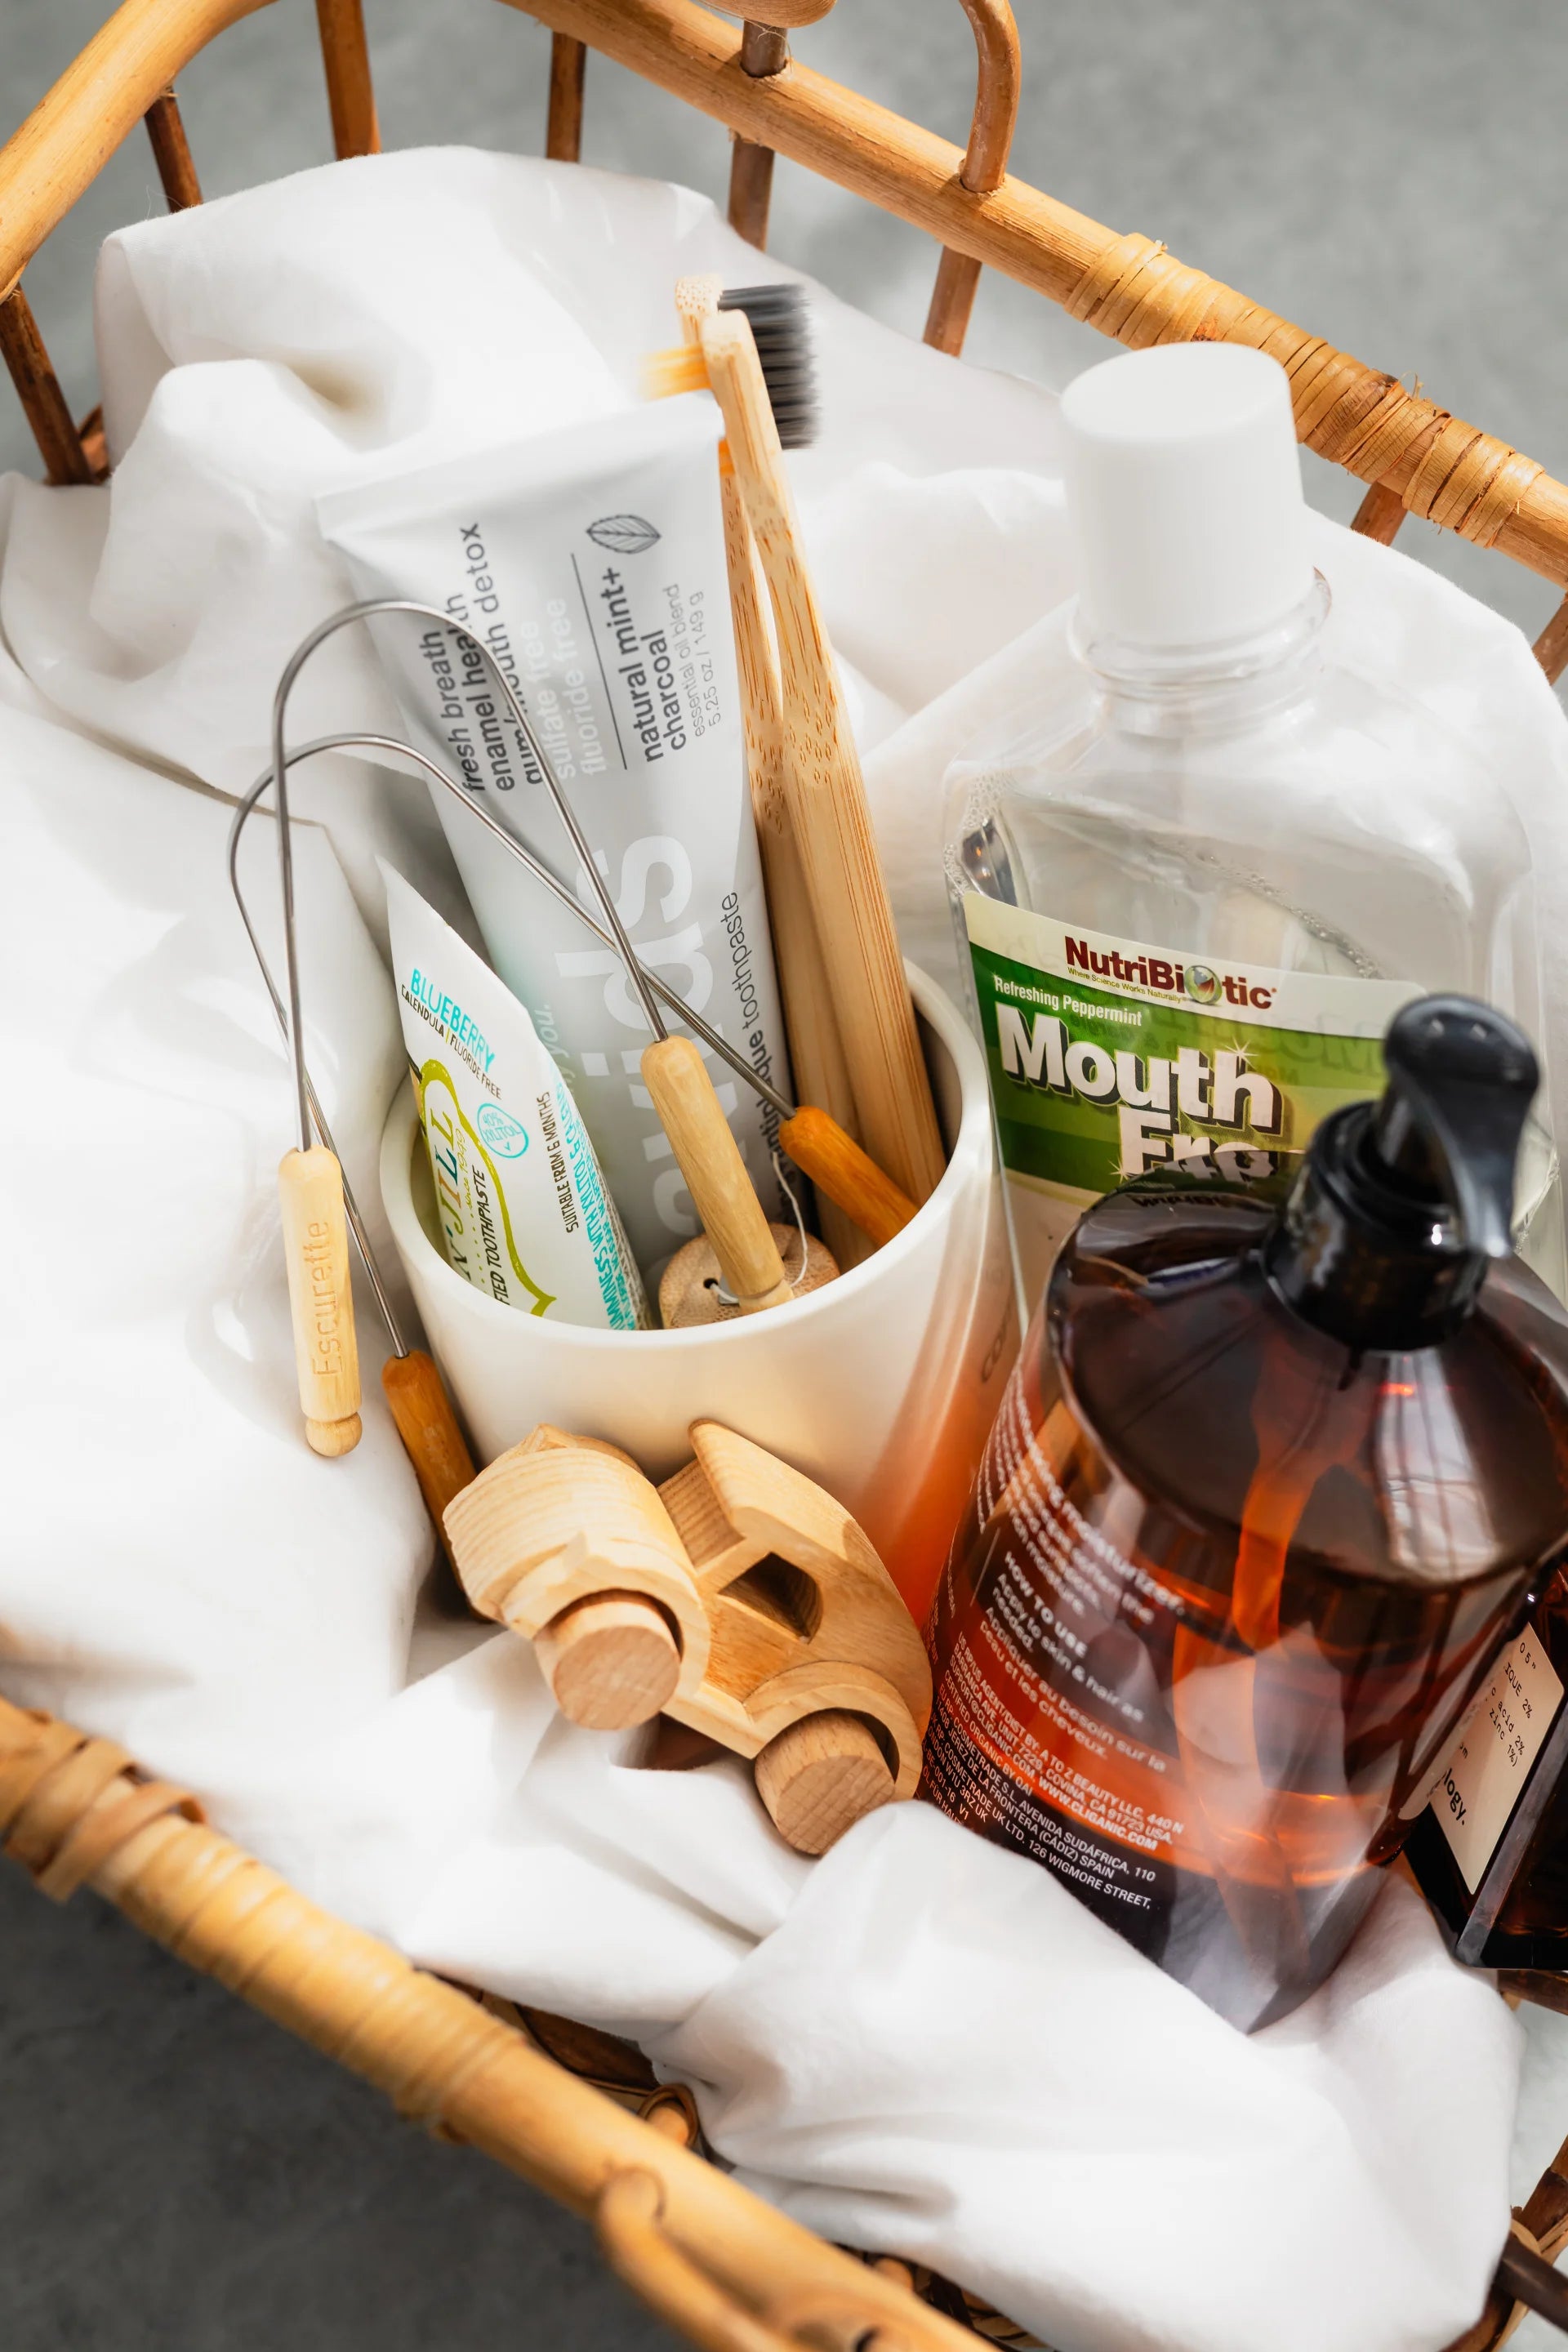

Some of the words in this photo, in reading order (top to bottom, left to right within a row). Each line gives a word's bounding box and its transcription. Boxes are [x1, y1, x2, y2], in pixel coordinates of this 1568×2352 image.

[460, 523, 500, 612] detox
[520, 620, 550, 682] free
[546, 598, 578, 662] free
[600, 567, 639, 655] mint+
[662, 583, 687, 639] blend
[675, 638, 691, 660] oil
[689, 610, 707, 645] 149
[419, 630, 464, 719] breath
[640, 629, 687, 751] charcoal
[679, 662, 706, 737] essential
[701, 658, 715, 683] oz
[703, 686, 722, 727] 5.25
[466, 694, 514, 791] enamel
[537, 688, 576, 780] sulfate
[564, 669, 608, 776] fluoride
[618, 662, 664, 763] natural
[448, 728, 485, 791] fresh
[720, 892, 760, 1031] toothpaste
[993, 976, 1060, 1011] Refreshing
[1062, 994, 1143, 1027] Peppermint
[1067, 967, 1090, 981] Where
[1091, 974, 1120, 989] Science
[1121, 982, 1146, 995] Works
[401, 984, 444, 1038] CALENDULA
[449, 1033, 481, 1080] FLUORIDE
[480, 1073, 502, 1100] FREE
[411, 968, 496, 1073] BLUEBERRY
[995, 1001, 1282, 1134] Mouth
[455, 1128, 469, 1174] 1949
[536, 1091, 556, 1142] MONTHS
[546, 1139, 560, 1152] 6
[550, 1150, 568, 1184] FROM
[572, 1159, 595, 1209] XYLITOL
[471, 1164, 502, 1268] TOOTHPASTE
[557, 1183, 579, 1233] SUITABLE
[585, 1207, 605, 1252] WITH
[303, 1221, 342, 1377] Escurette
[594, 1245, 627, 1330] UMMINESS
[1005, 1552, 1033, 1597] HOW
[1034, 1595, 1054, 1624] TO
[1054, 1621, 1088, 1659] USE
[1018, 1678, 1038, 1704] les
[1027, 1615, 1042, 1639] to
[1040, 1637, 1072, 1673] skin
[1071, 1664, 1085, 1682] &
[1086, 1677, 1121, 1708] hair
[1121, 1701, 1145, 1723] as
[1521, 1699, 1534, 1719] 2%
[944, 1669, 970, 1723] CERTIFIED
[969, 1721, 1004, 1767] ORGANIC
[1002, 1762, 1017, 1780] BY
[1015, 1775, 1033, 1797] QAI
[954, 1642, 983, 1703] BARRANCA
[998, 1721, 1019, 1747] UNIT
[1089, 1798, 1106, 1815] CA
[1107, 1808, 1145, 1833] 91723
[1039, 1679, 1059, 1701] au
[1116, 1740, 1148, 1764] sur
[1489, 1708, 1506, 1741] zinc
[1498, 1700, 1515, 1733] acid
[1514, 1735, 1526, 1756] 2%
[928, 1726, 947, 1766] ONDON
[945, 1762, 962, 1788] W1U
[960, 1784, 977, 1809] 3RZ
[974, 1802, 989, 1824] UK
[929, 1779, 943, 1803] FÜR
[939, 1683, 947, 1702] EU
[953, 1717, 1003, 1787] COSMETRADE
[1019, 1800, 1064, 1838] AVENIDA
[1134, 1867, 1156, 1883] 110
[948, 1729, 969, 1762] JEREZ
[967, 1757, 980, 1776] DE
[978, 1772, 989, 1789] LA
[989, 1784, 1040, 1836] FRONTERA
[1079, 1854, 1116, 1880] SPAIN
[959, 1803, 969, 1821] V1
[1038, 1775, 1159, 1851] WWW.CLIGANIC.COM
[1040, 1748, 1049, 1762] A
[1049, 1754, 1065, 1772] TO
[1073, 1773, 1120, 1806] BEAUTY
[1147, 1813, 1173, 1831] 440
[1172, 1821, 1185, 1835] N
[944, 1742, 995, 1812] COSMETRADE
[992, 1806, 1008, 1827] UK
[1005, 1820, 1026, 1844] LTD.
[1028, 1839, 1047, 1860] 126
[1048, 1853, 1104, 1892] WIGMORE
[1103, 1882, 1152, 1910] STREET,
